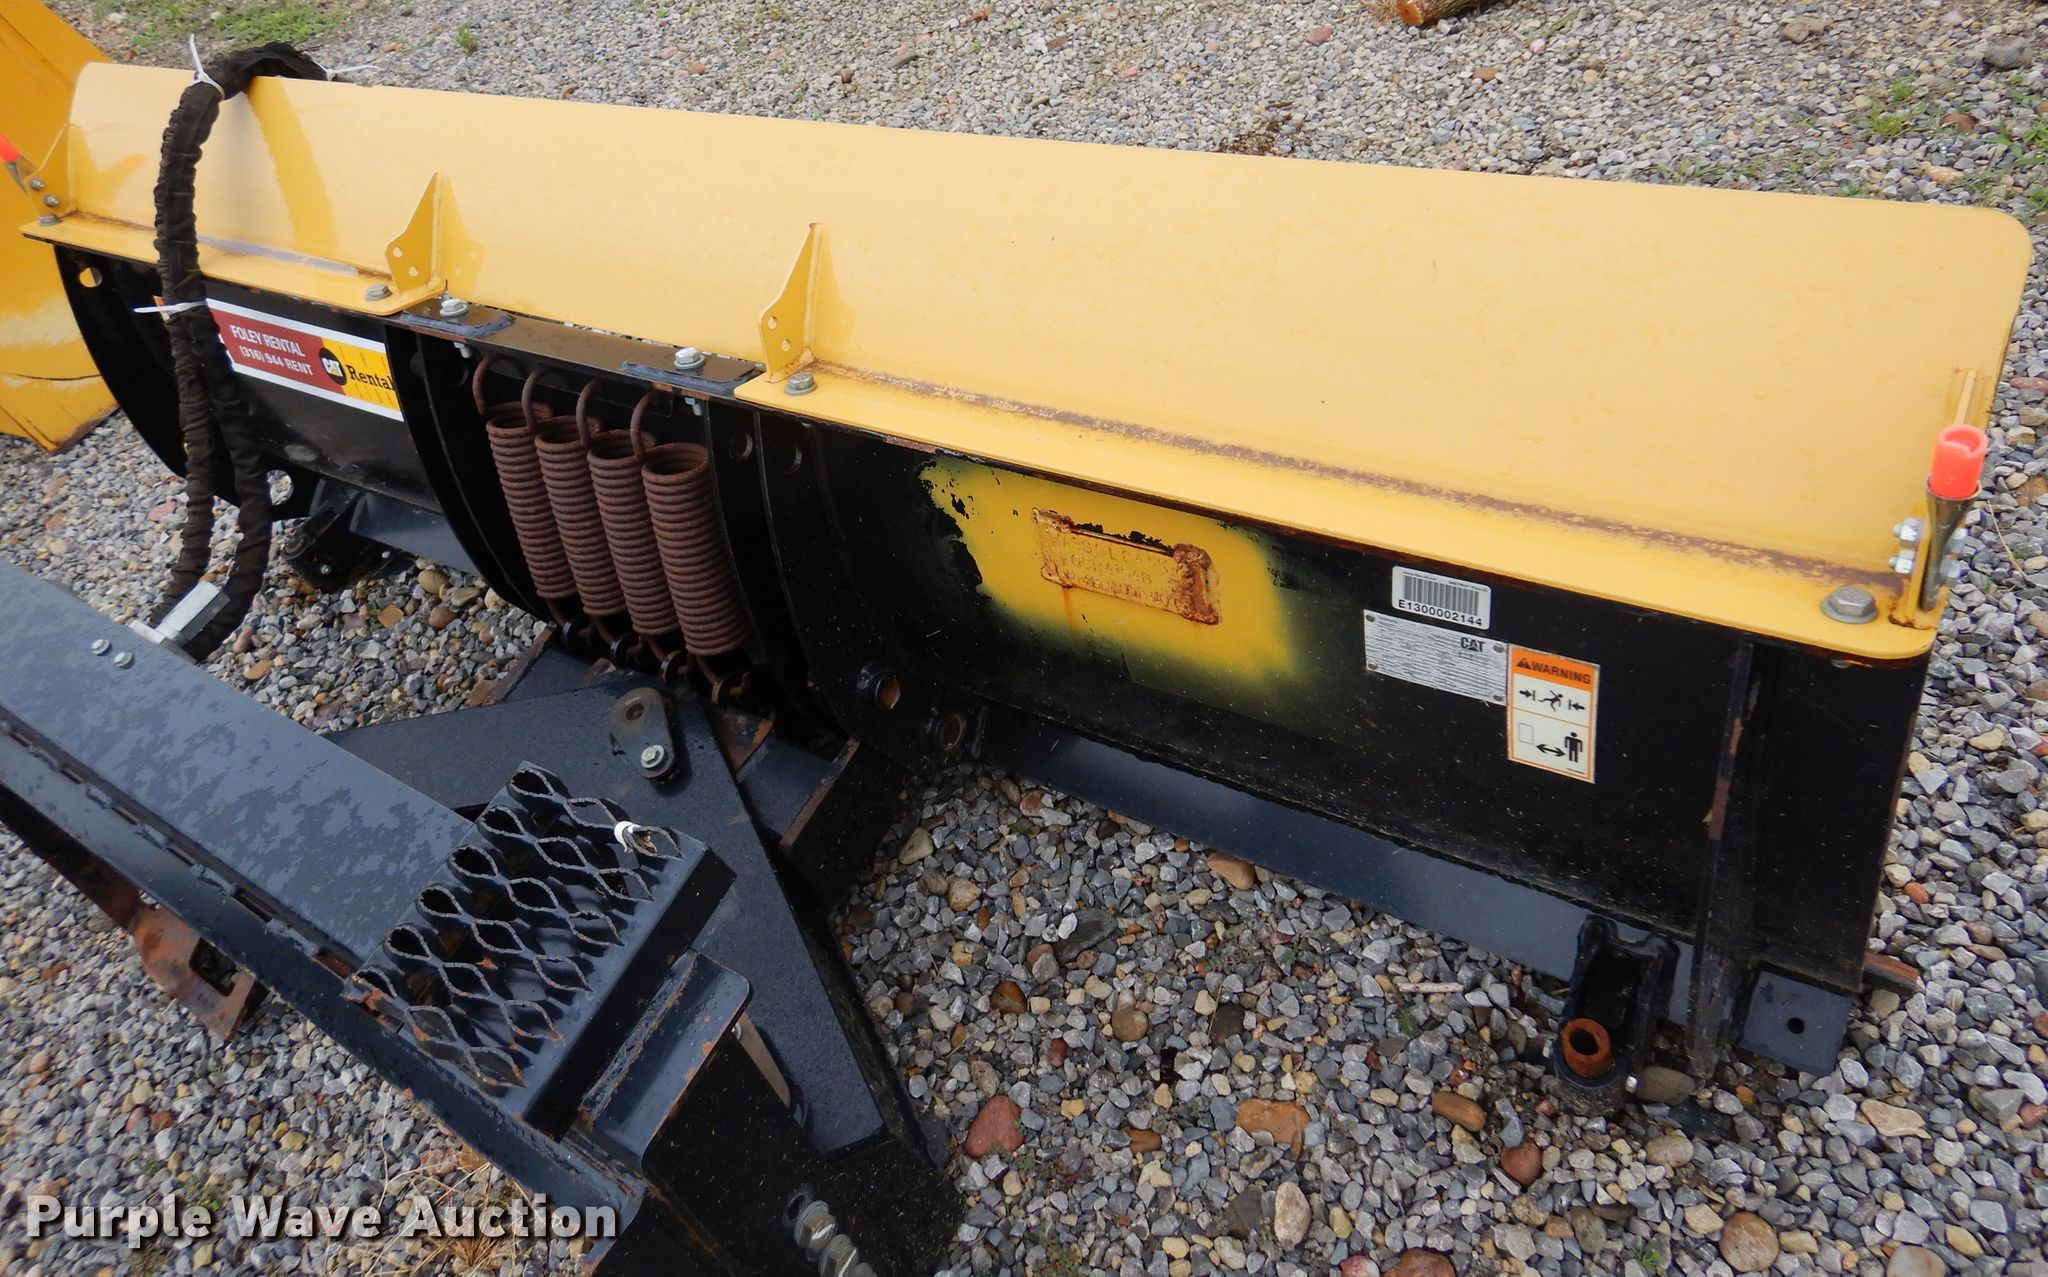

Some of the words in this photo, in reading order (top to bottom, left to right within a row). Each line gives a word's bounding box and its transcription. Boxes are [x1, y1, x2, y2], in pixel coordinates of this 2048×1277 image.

[230, 324, 264, 345] FOLEY
[263, 334, 305, 357] RENTAL
[240, 345, 265, 363] (316)
[266, 352, 284, 367] 944
[286, 357, 314, 376] RENT
[322, 357, 344, 377] CAT
[346, 364, 396, 391] Rental
[1398, 599, 1483, 627] E1300002144
[1460, 636, 1486, 653] CAT
[1530, 660, 1591, 685] WARNING
